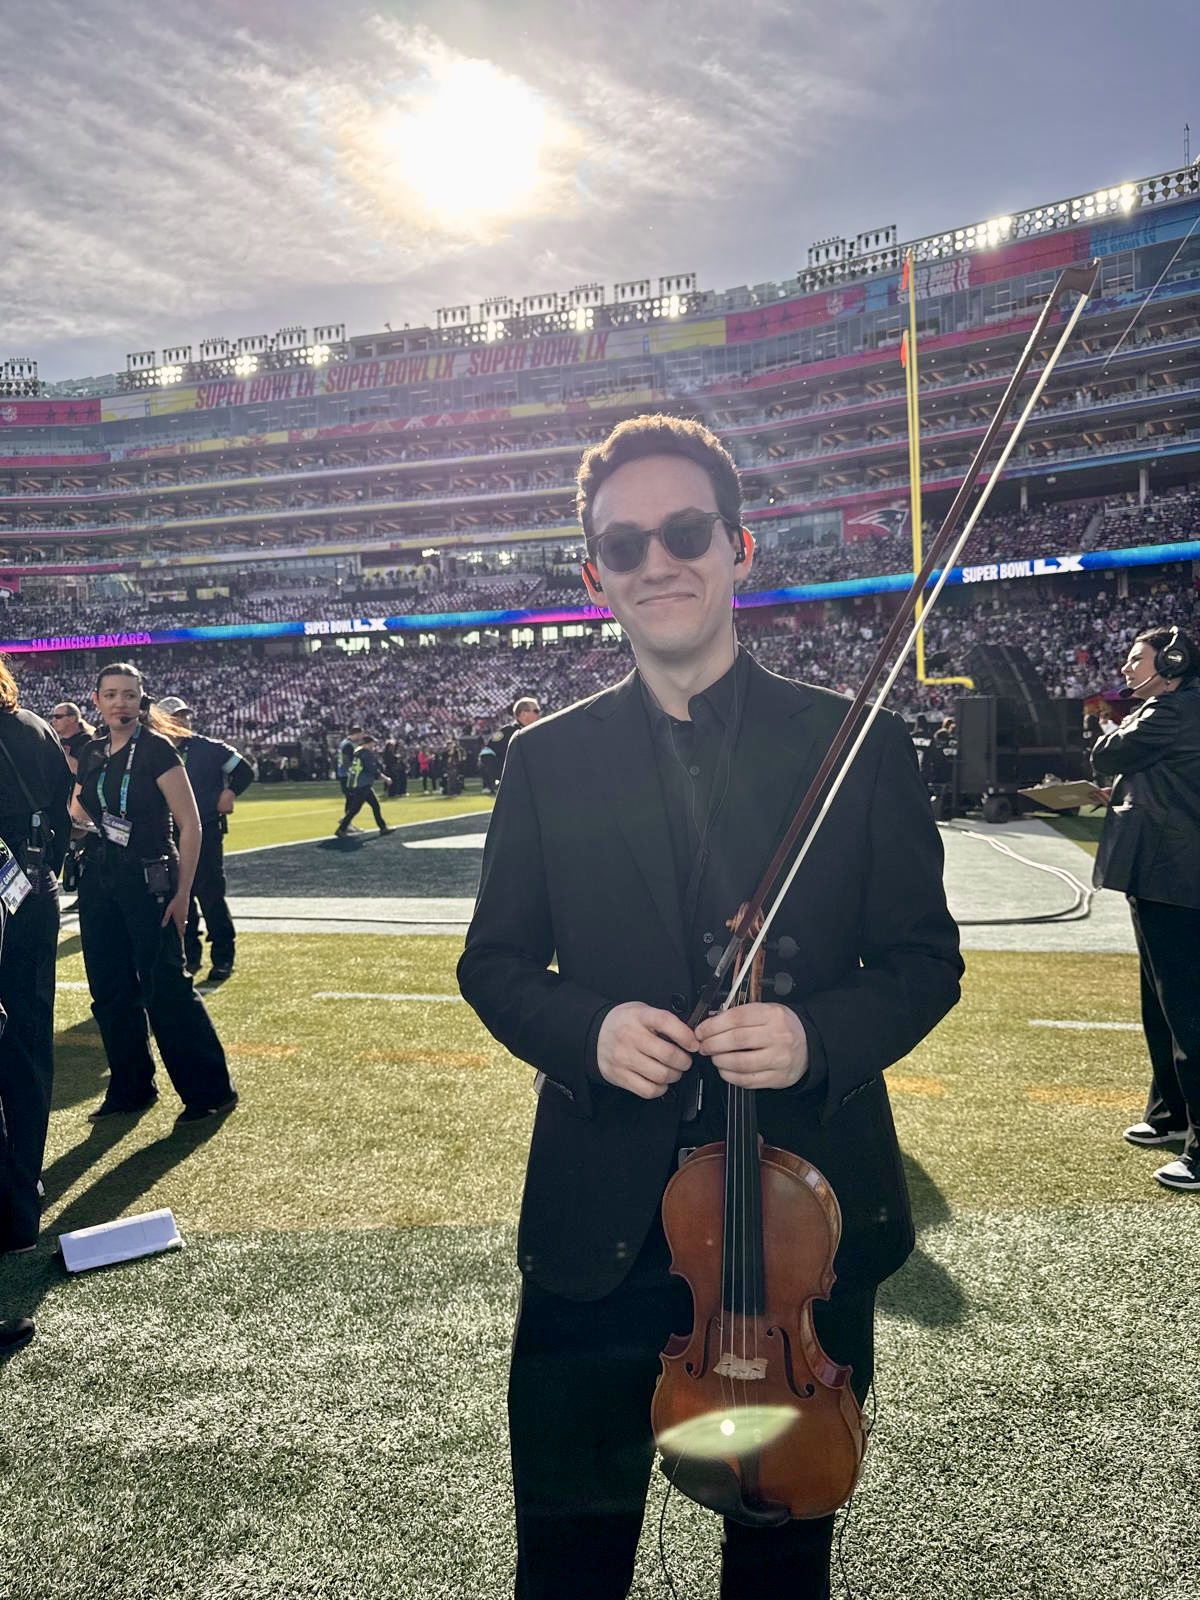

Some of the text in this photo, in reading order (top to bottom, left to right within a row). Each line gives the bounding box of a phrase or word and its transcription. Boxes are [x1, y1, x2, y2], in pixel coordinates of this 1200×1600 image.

[469, 331, 610, 376] SUPER BOWL LX
[325, 353, 456, 394] SUPER BOWL LX
[195, 382, 245, 410] SUPER
[249, 373, 291, 403] BOWL
[962, 555, 1084, 584] SUPER BOWL LX
[32, 631, 151, 650] SAN FRANCISCO BAY AREA
[304, 617, 388, 636] SUPER BOWL LX
